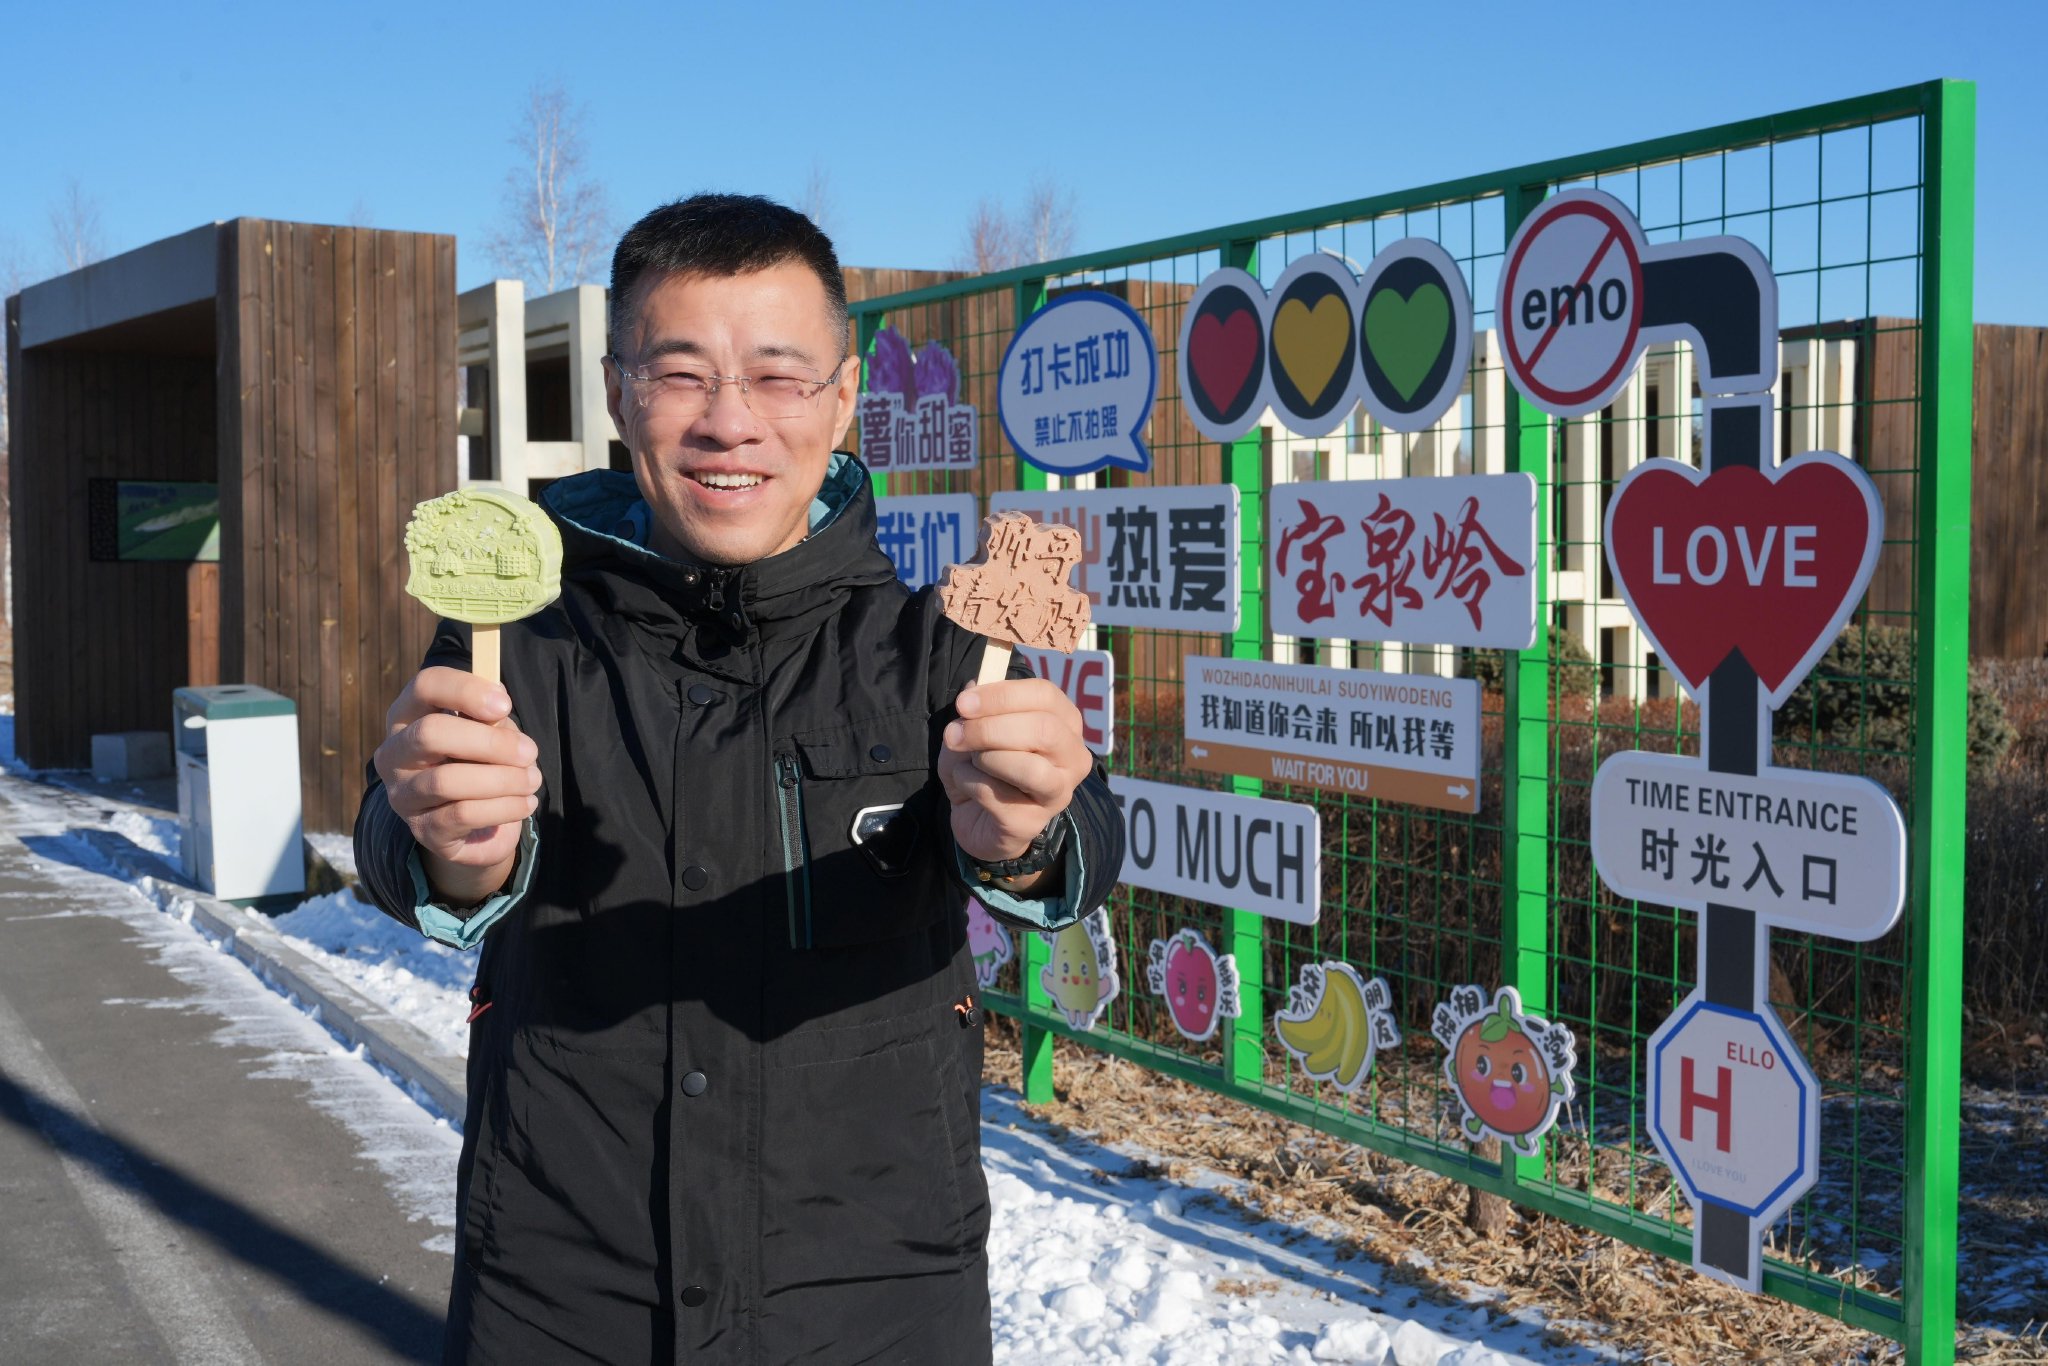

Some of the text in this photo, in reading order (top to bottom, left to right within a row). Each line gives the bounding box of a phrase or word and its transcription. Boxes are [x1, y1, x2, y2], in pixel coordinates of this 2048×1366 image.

[1522, 278, 1627, 330] emo
[1021, 329, 1130, 395] 打卡成功
[1035, 405, 1118, 447] 禁止不拍照
[1276, 492, 1526, 632] 宝泉岭
[1652, 525, 1818, 588] LOVE
[1202, 668, 1453, 709] WOZHIDAONIHUILAI SUOYIWODENG
[1200, 694, 1455, 761] 我知道你会来 所以我等
[1272, 757, 1368, 791] WAIT FOR YOU
[1625, 778, 1858, 836] TIME ENTRANCE
[1113, 794, 1303, 904] O MUCH
[1641, 827, 1837, 905] 时光入口
[1727, 1041, 1775, 1070] ELLO
[1697, 1160, 1723, 1177] LOVE
[1725, 1168, 1748, 1184] YOU
